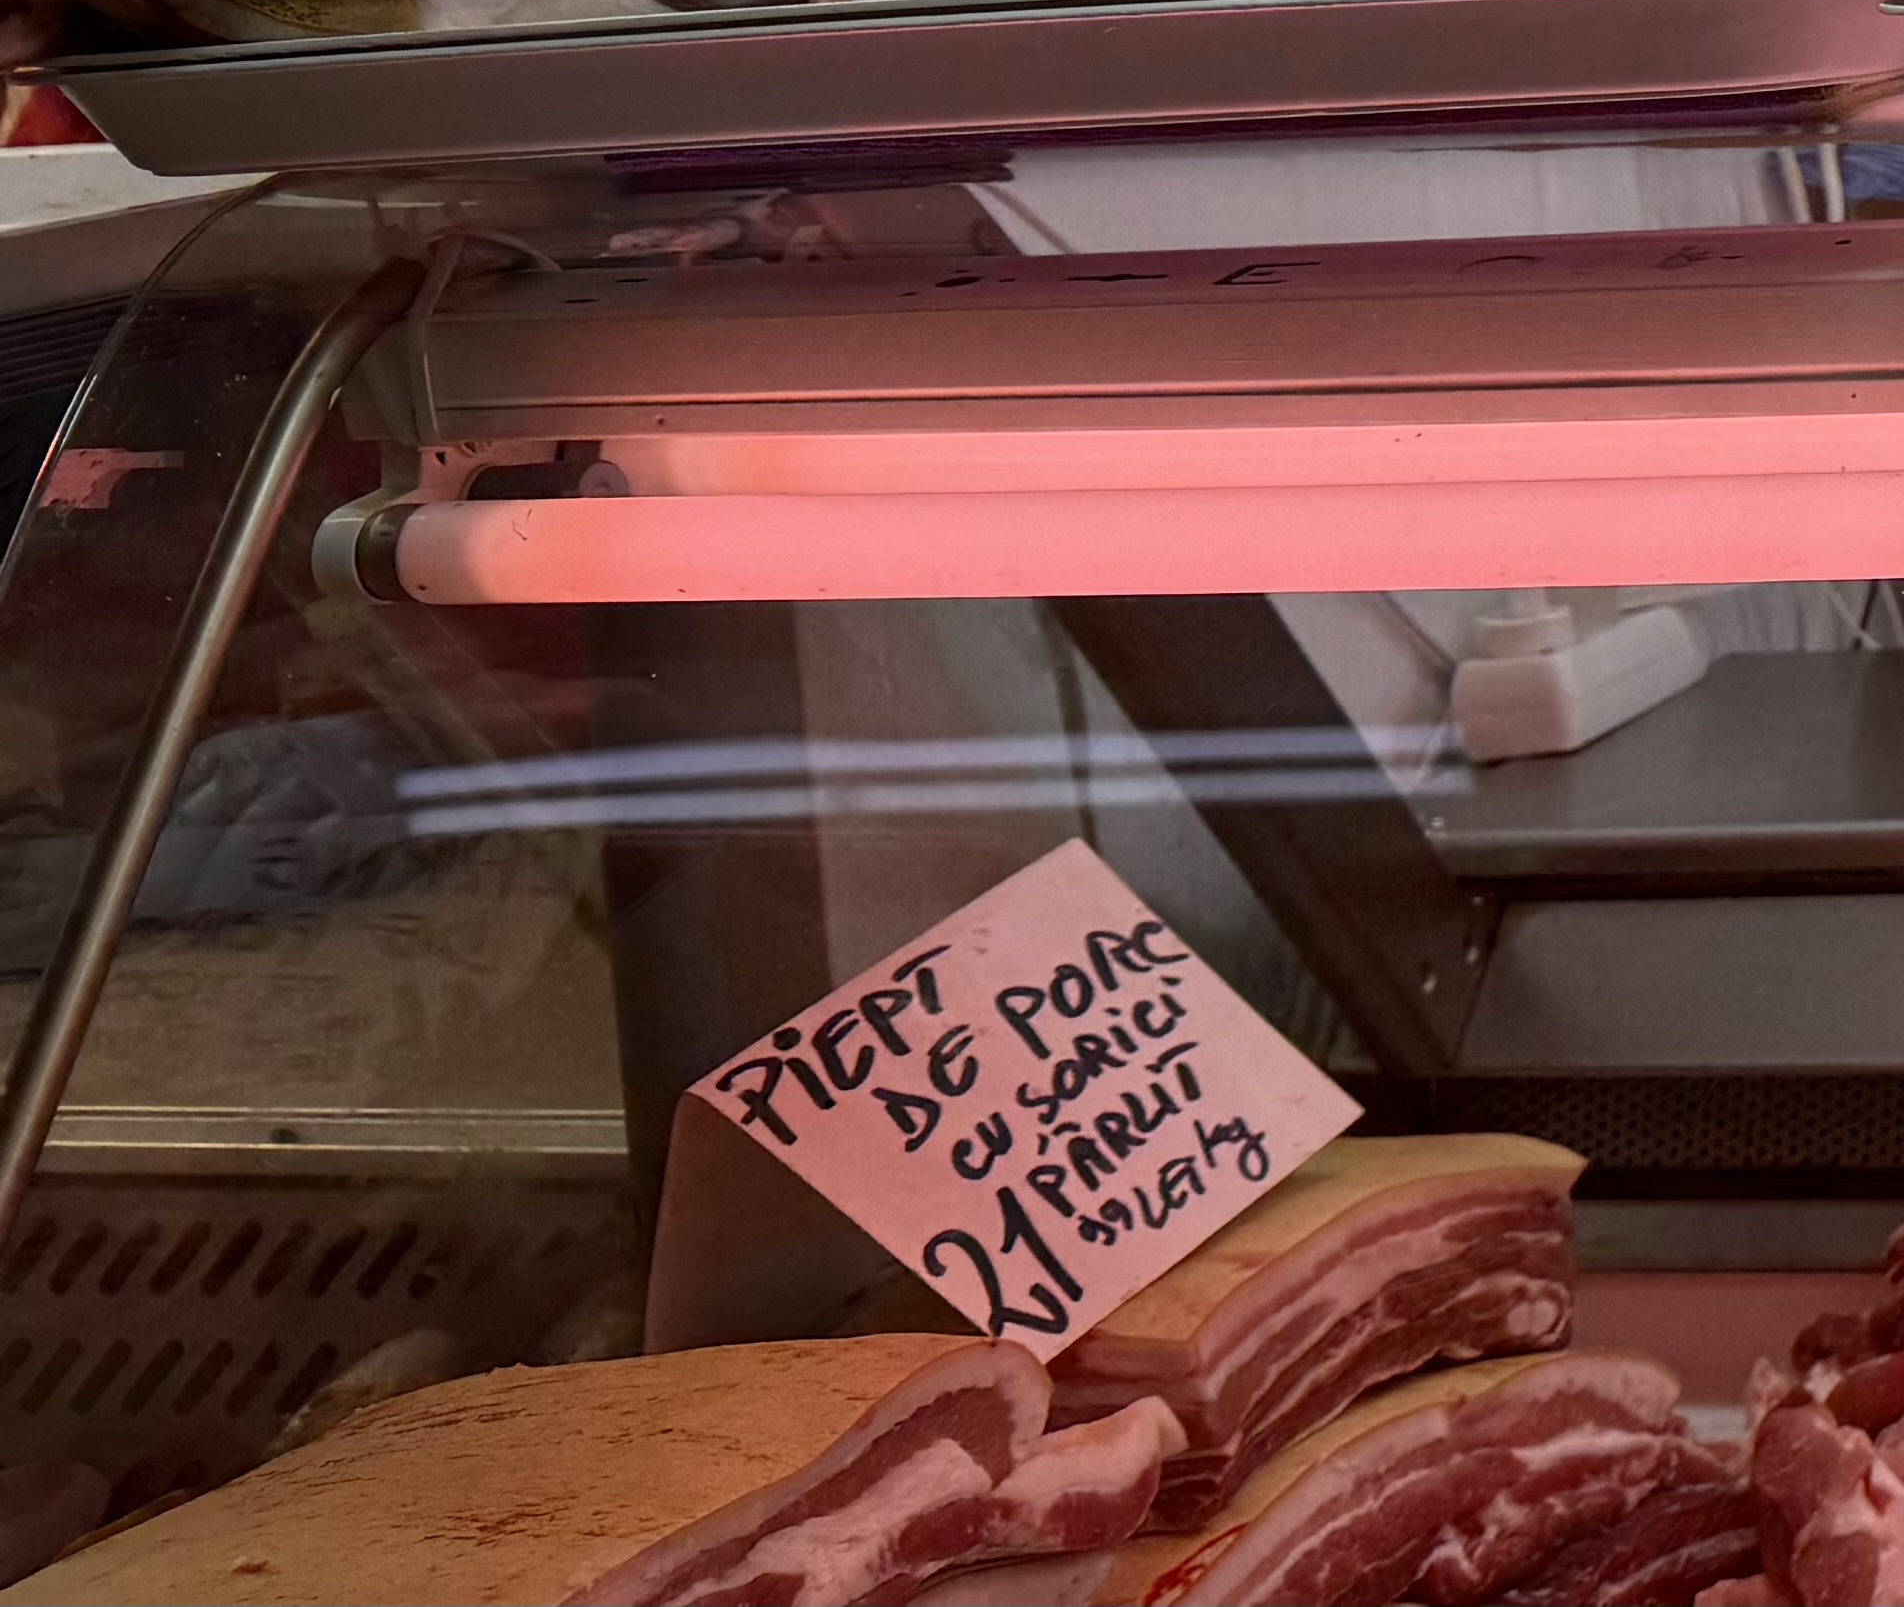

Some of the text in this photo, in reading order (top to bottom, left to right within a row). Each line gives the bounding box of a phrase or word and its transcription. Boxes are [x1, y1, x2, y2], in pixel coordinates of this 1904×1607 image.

[715, 944, 952, 1146] PIEPT
[871, 920, 1190, 1152] DE PORC
